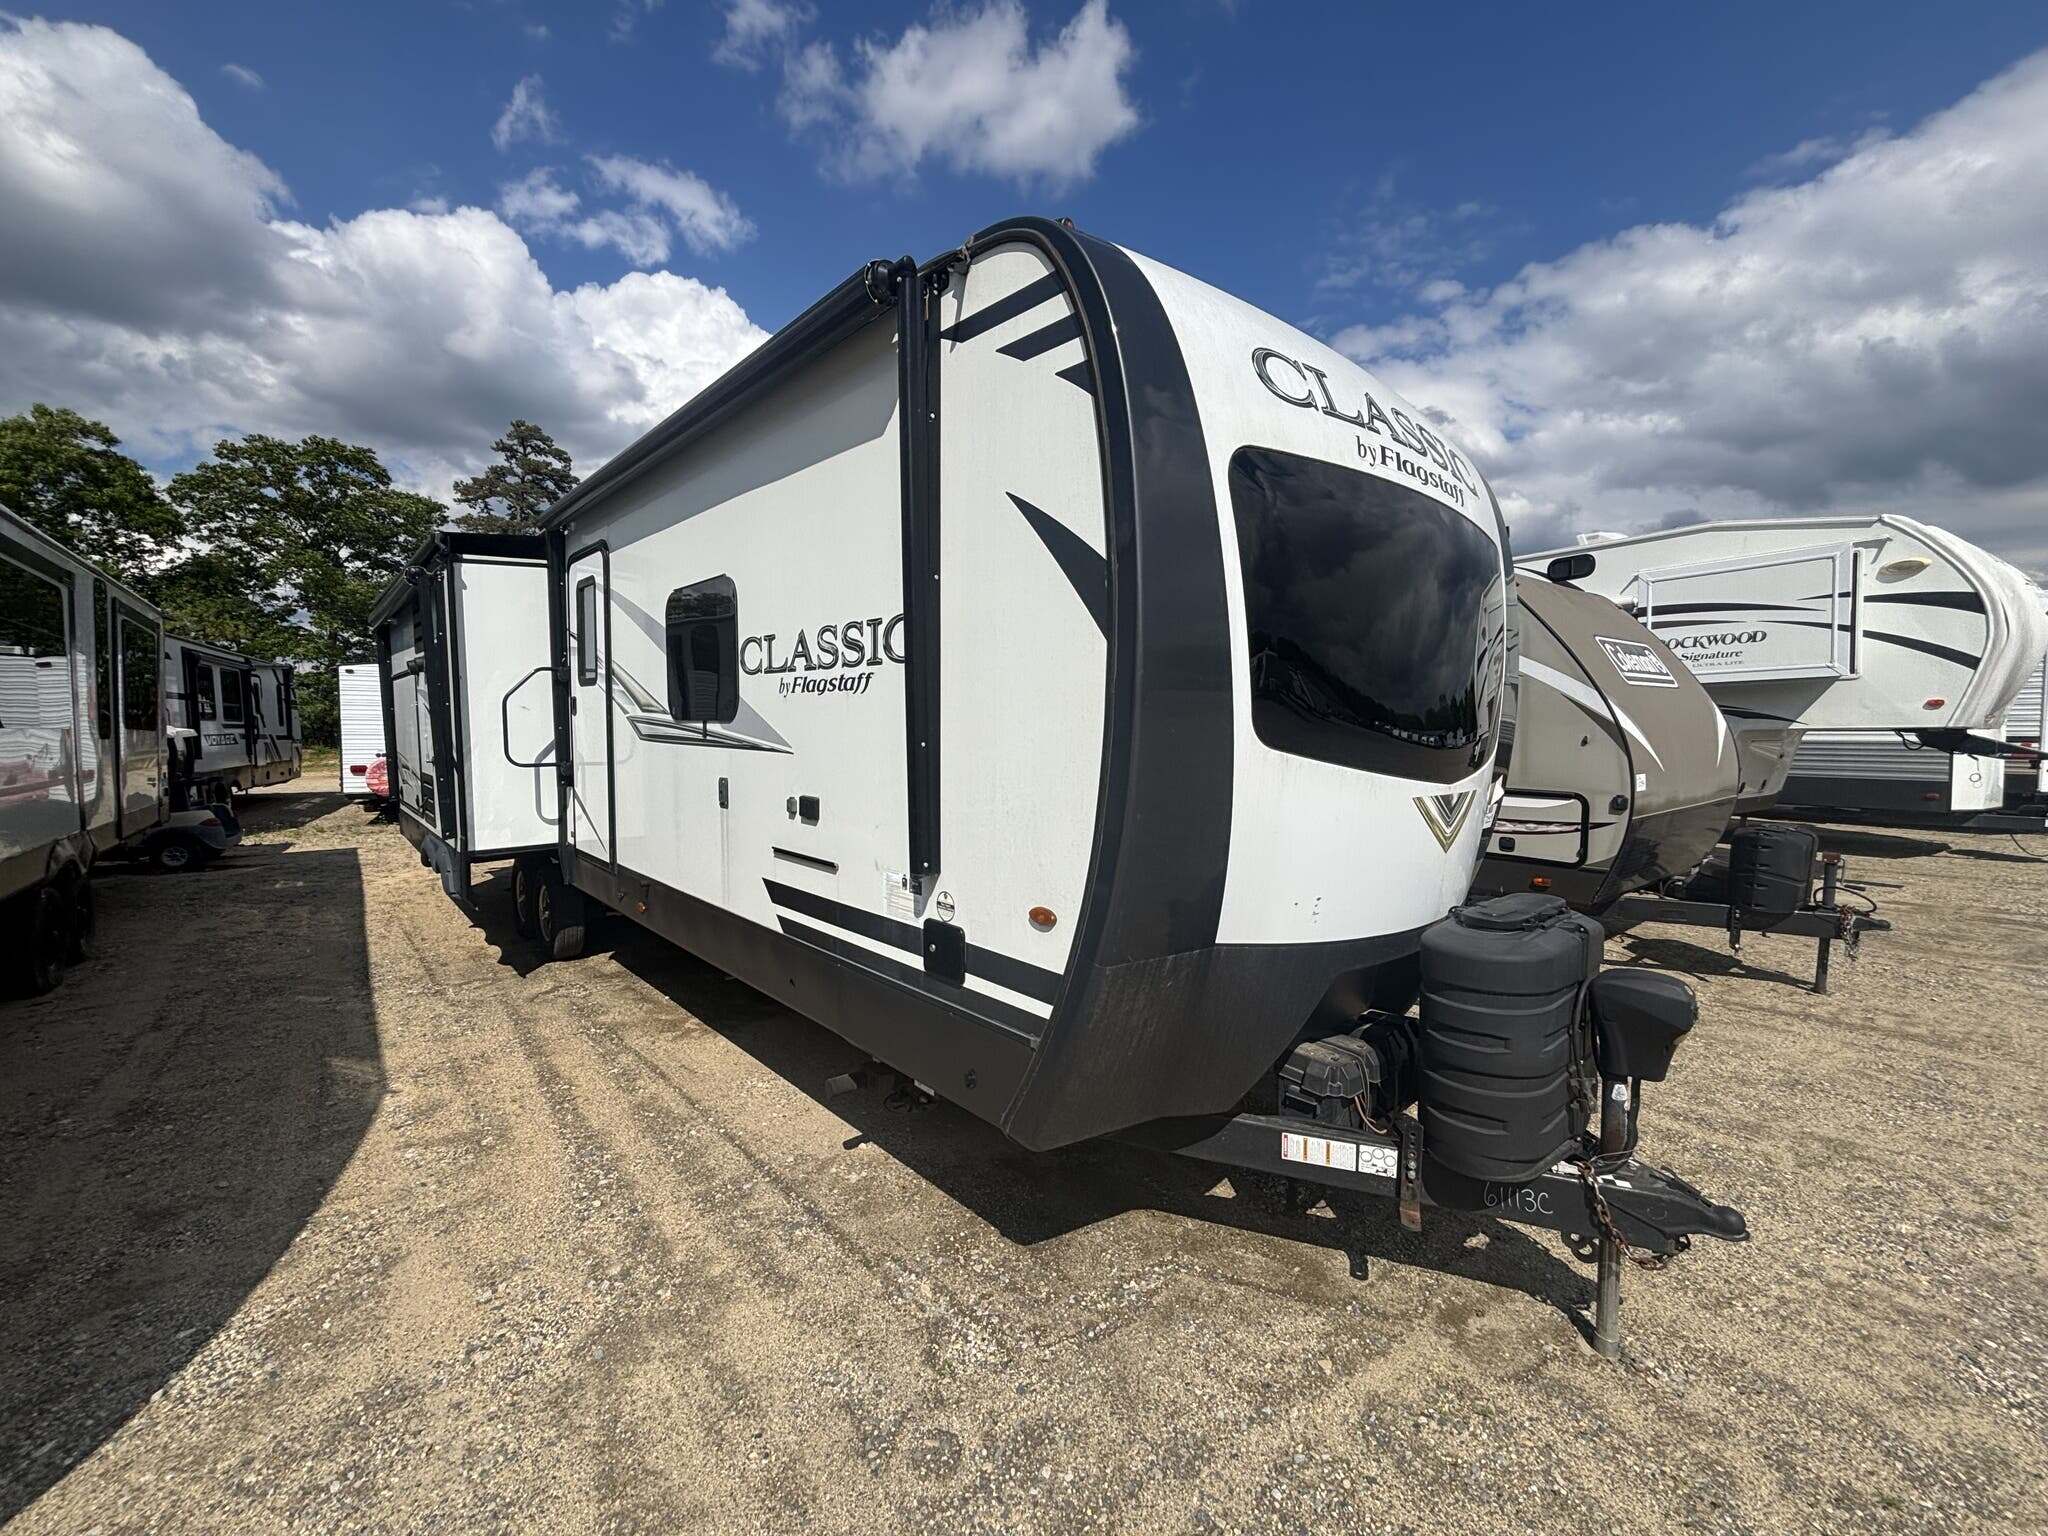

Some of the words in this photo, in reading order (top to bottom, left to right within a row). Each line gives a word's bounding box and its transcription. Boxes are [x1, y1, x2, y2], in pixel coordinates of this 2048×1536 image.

[1251, 347, 1479, 499] CLASSIC
[1356, 434, 1378, 468] by
[1380, 445, 1465, 506] Flagstaff
[1663, 631, 1767, 649] OCKWOOD
[1604, 643, 1663, 673] Coleman
[1681, 650, 1744, 663] Signature
[779, 678, 791, 697] by
[791, 672, 874, 695] Flagstaff
[1483, 1181, 1553, 1215] 61113C
